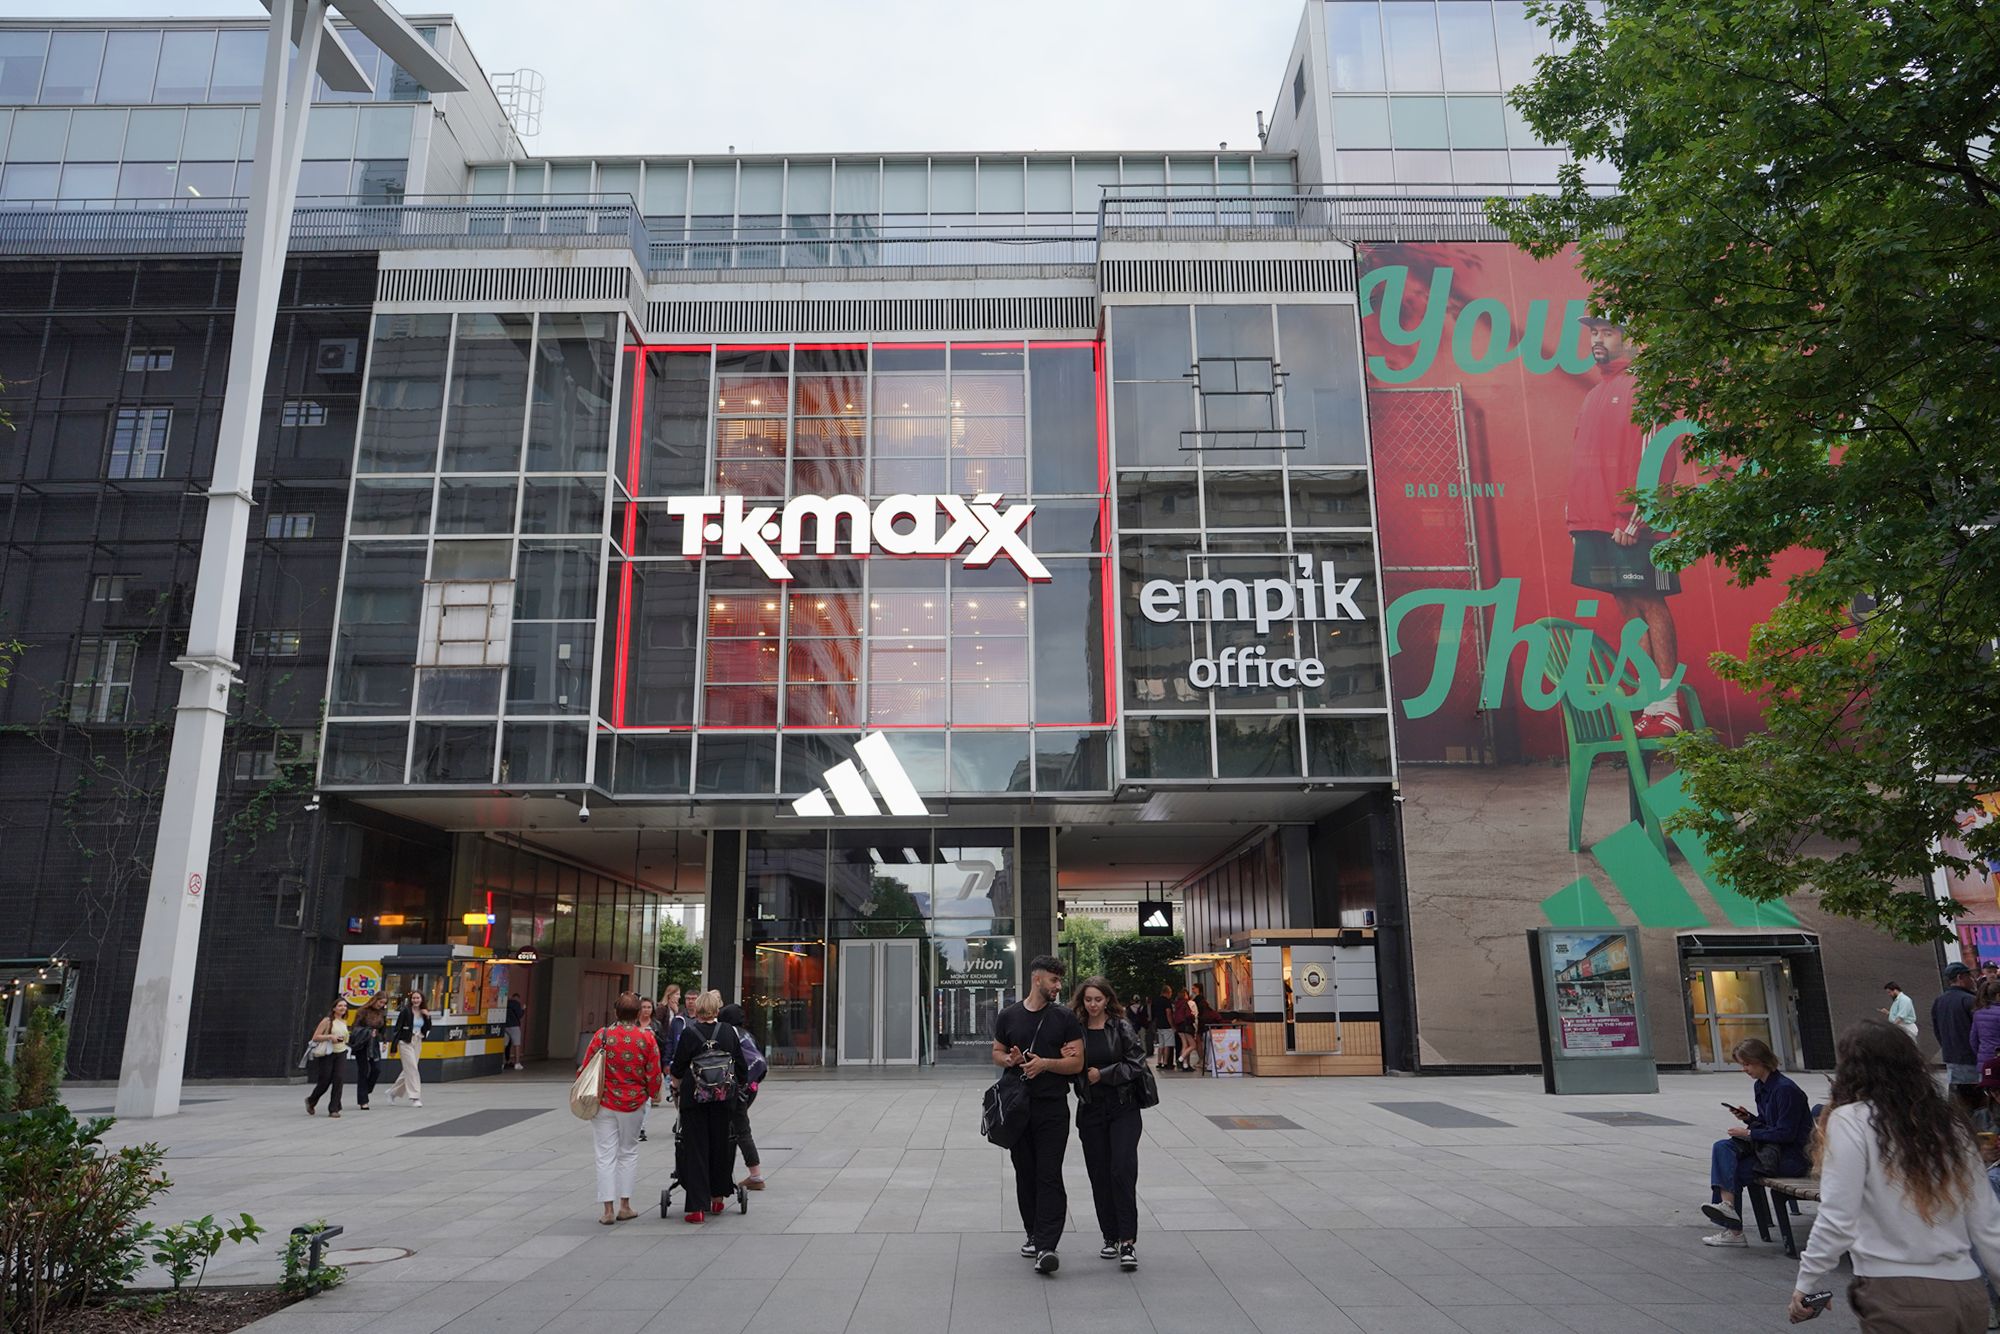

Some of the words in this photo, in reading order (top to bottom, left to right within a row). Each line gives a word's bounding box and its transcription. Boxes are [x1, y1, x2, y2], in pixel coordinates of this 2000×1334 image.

[1359, 265, 1595, 384] You
[1405, 483, 1439, 498] BAD
[1447, 482, 1505, 498] BUNNY
[1139, 553, 1366, 634] empik
[1188, 645, 1326, 688] office
[1386, 578, 1687, 719] This
[946, 958, 1003, 972] ytion
